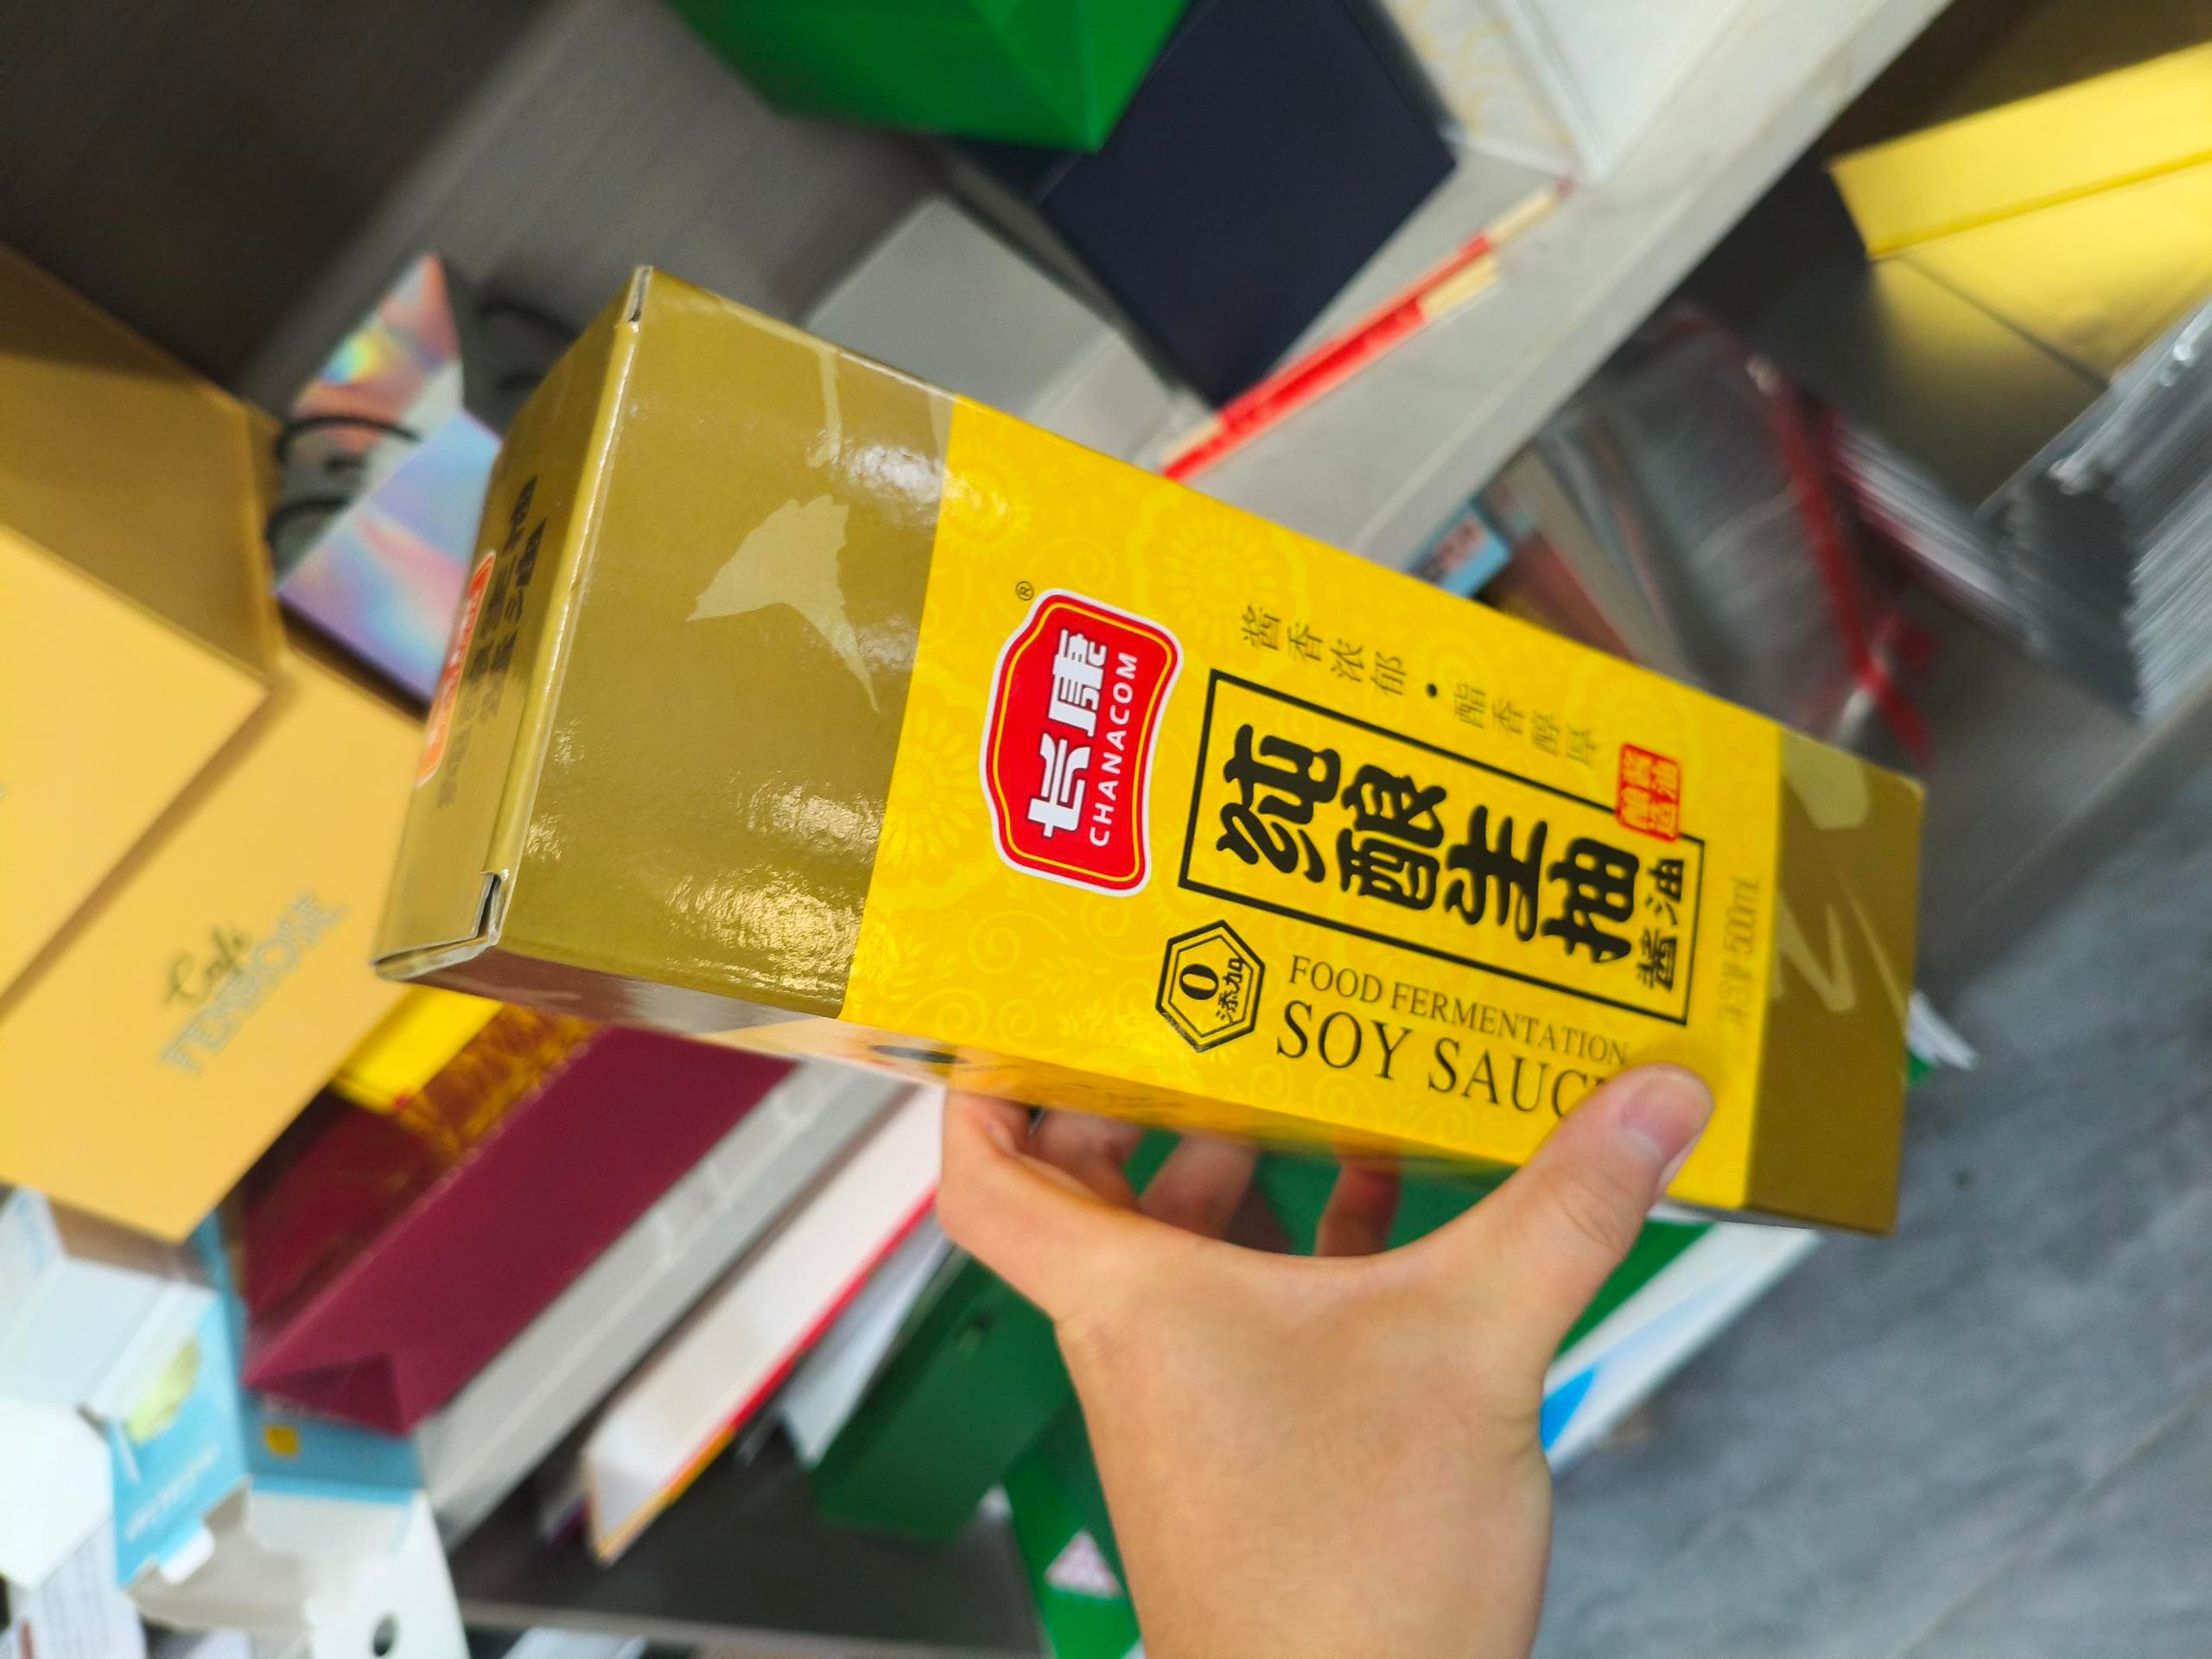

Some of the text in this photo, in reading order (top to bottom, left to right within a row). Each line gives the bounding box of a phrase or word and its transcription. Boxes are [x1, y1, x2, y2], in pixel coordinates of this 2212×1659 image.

[1027, 628, 1109, 839] 长康
[1088, 652, 1139, 848] CHANACOM
[1216, 723, 1641, 964] 纯酿生抽
[1179, 963, 1220, 1001] 0
[1215, 951, 1245, 1027] 添加
[1636, 858, 1685, 993] 酱油
[1276, 999, 1611, 1120] SOY SAUC
[1288, 954, 1630, 1066] FOOD FERMENTATION
